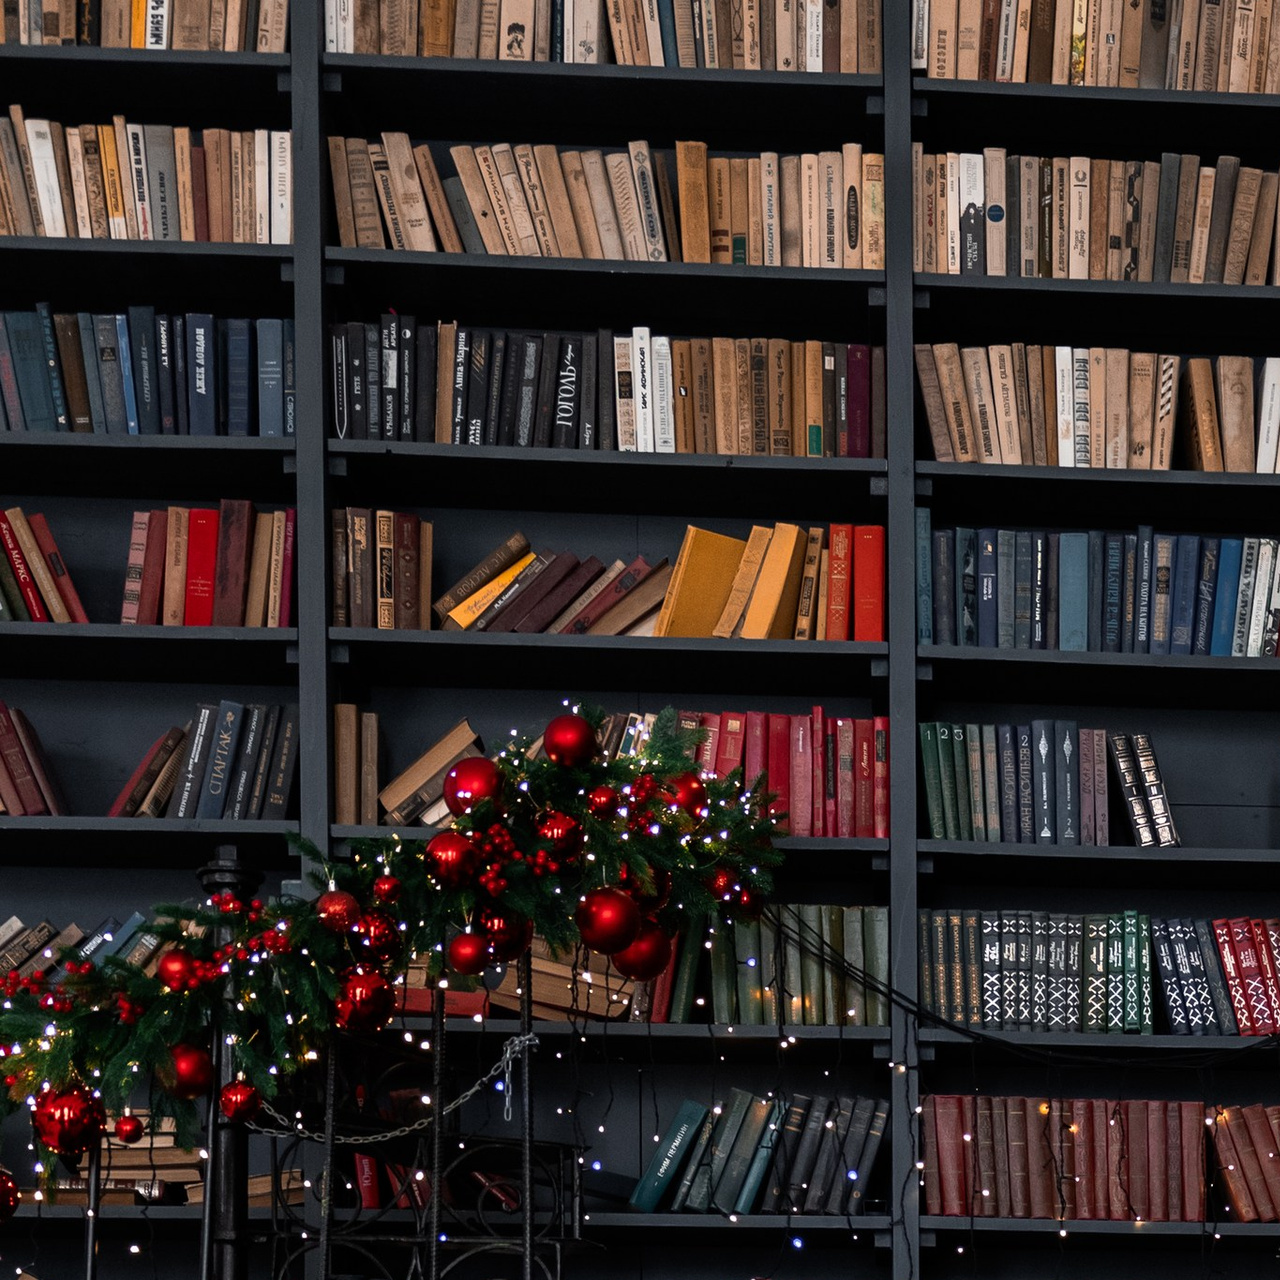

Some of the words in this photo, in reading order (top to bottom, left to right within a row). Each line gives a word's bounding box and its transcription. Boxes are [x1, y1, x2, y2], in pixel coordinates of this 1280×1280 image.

[766, 184, 774, 220] ВИТАЛИЙ
[195, 328, 205, 365] ЛОНДОН
[196, 366, 206, 394] ДЖЕК
[639, 347, 647, 389] АФИНСКАЯ
[556, 366, 576, 427] ГОГОЛЬ
[1139, 582, 1149, 605] ОХОТА
[1139, 605, 1148, 613] НА
[1138, 614, 1148, 641] КИТОВ
[940, 728, 949, 739] 2
[1021, 735, 1029, 746] 2
[208, 730, 232, 795] СПАРТАК
[1003, 750, 1014, 806] ВАСИЛЬЕВ
[1020, 748, 1031, 804] ВАСИЛЬЕВ
[664, 1123, 690, 1158] ПЕРМИТИН
[656, 1157, 674, 1178] ЕФИМ
